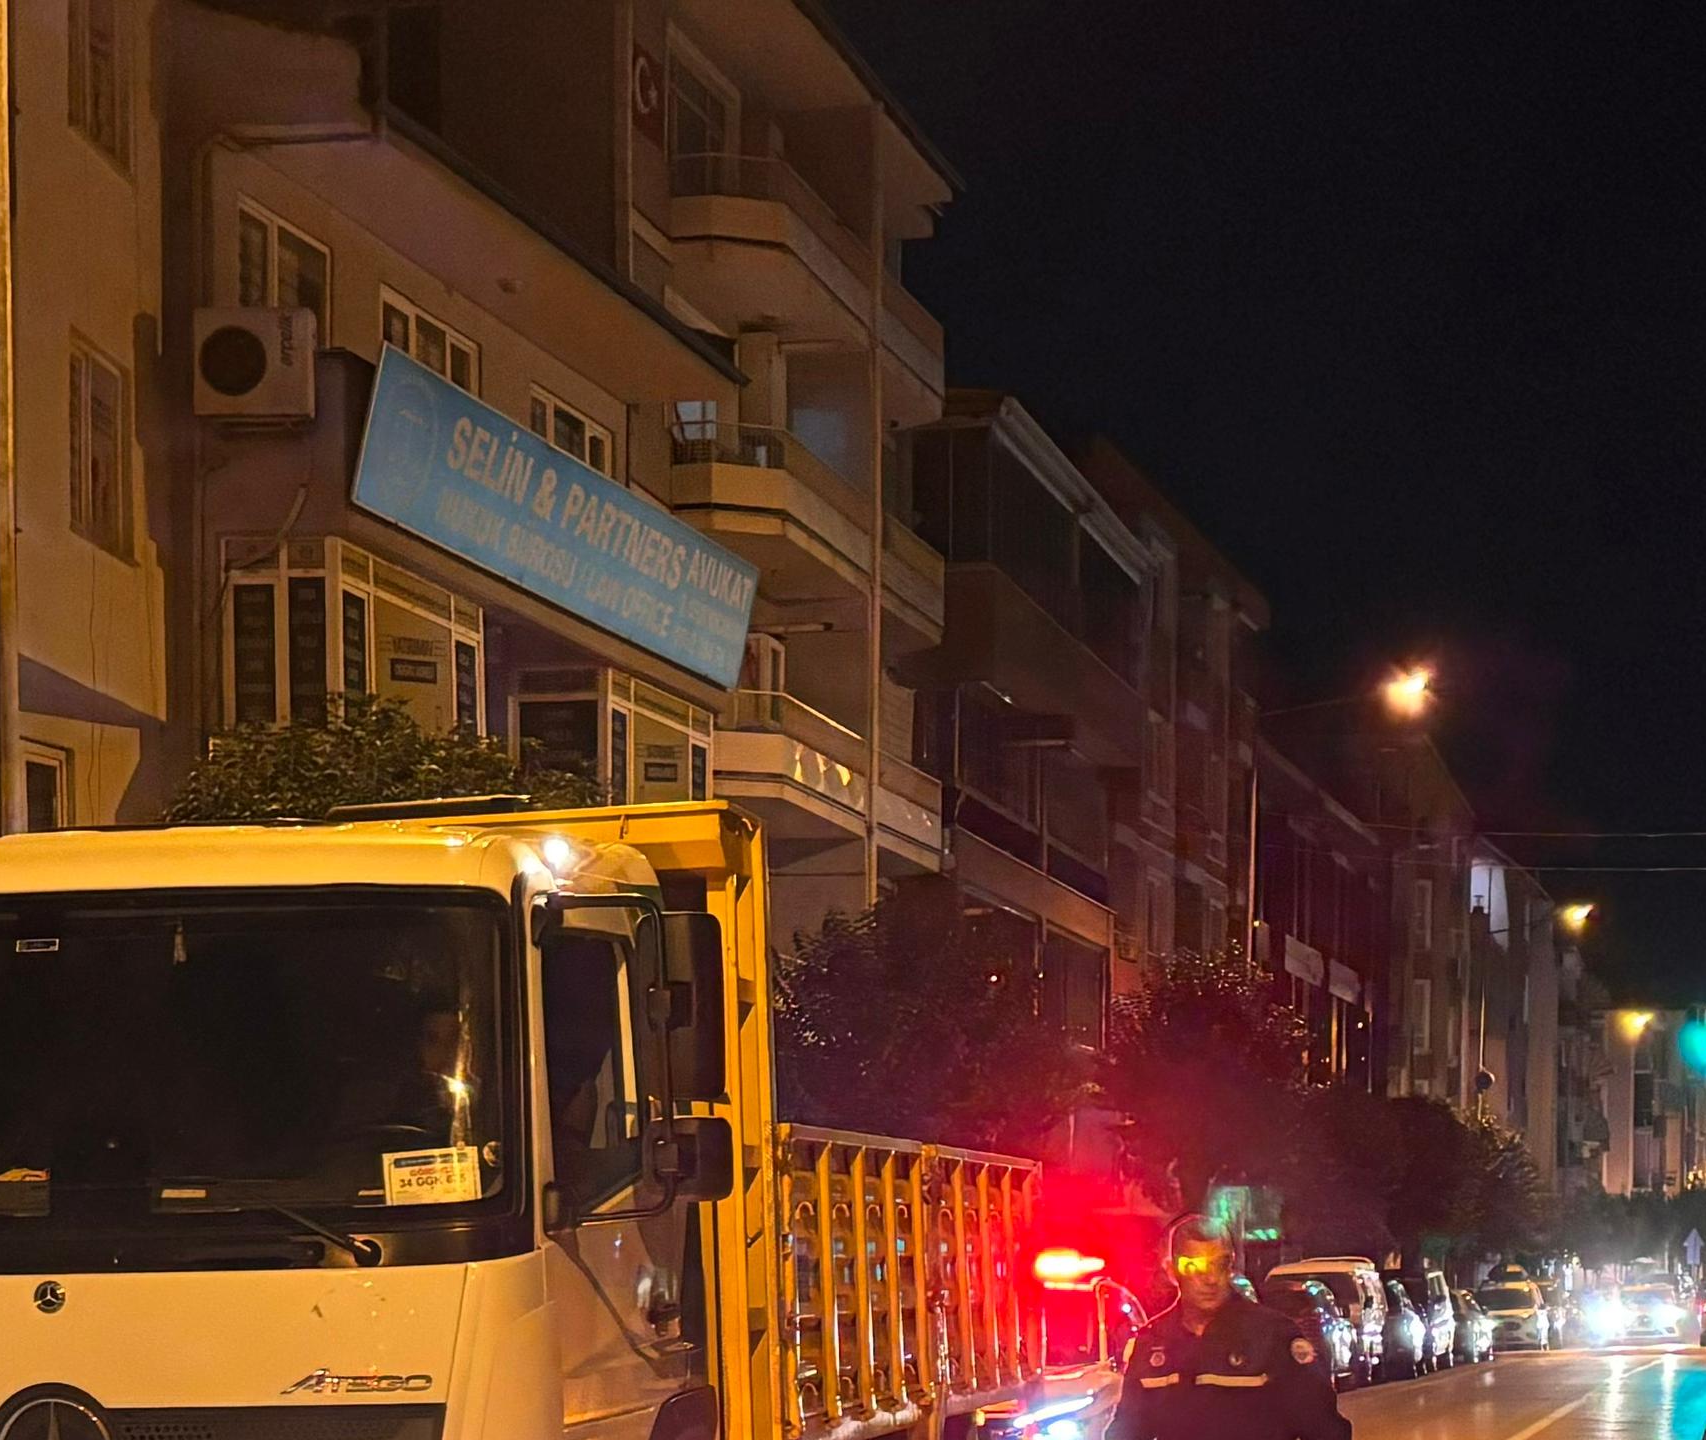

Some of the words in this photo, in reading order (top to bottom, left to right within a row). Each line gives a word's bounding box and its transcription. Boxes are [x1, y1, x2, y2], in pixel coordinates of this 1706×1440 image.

[447, 416, 535, 506] SELİN
[532, 467, 559, 521] &
[560, 484, 688, 590] PARTNERS
[687, 550, 753, 612] AVUKAT
[280, 1368, 433, 1395] ATEGO
